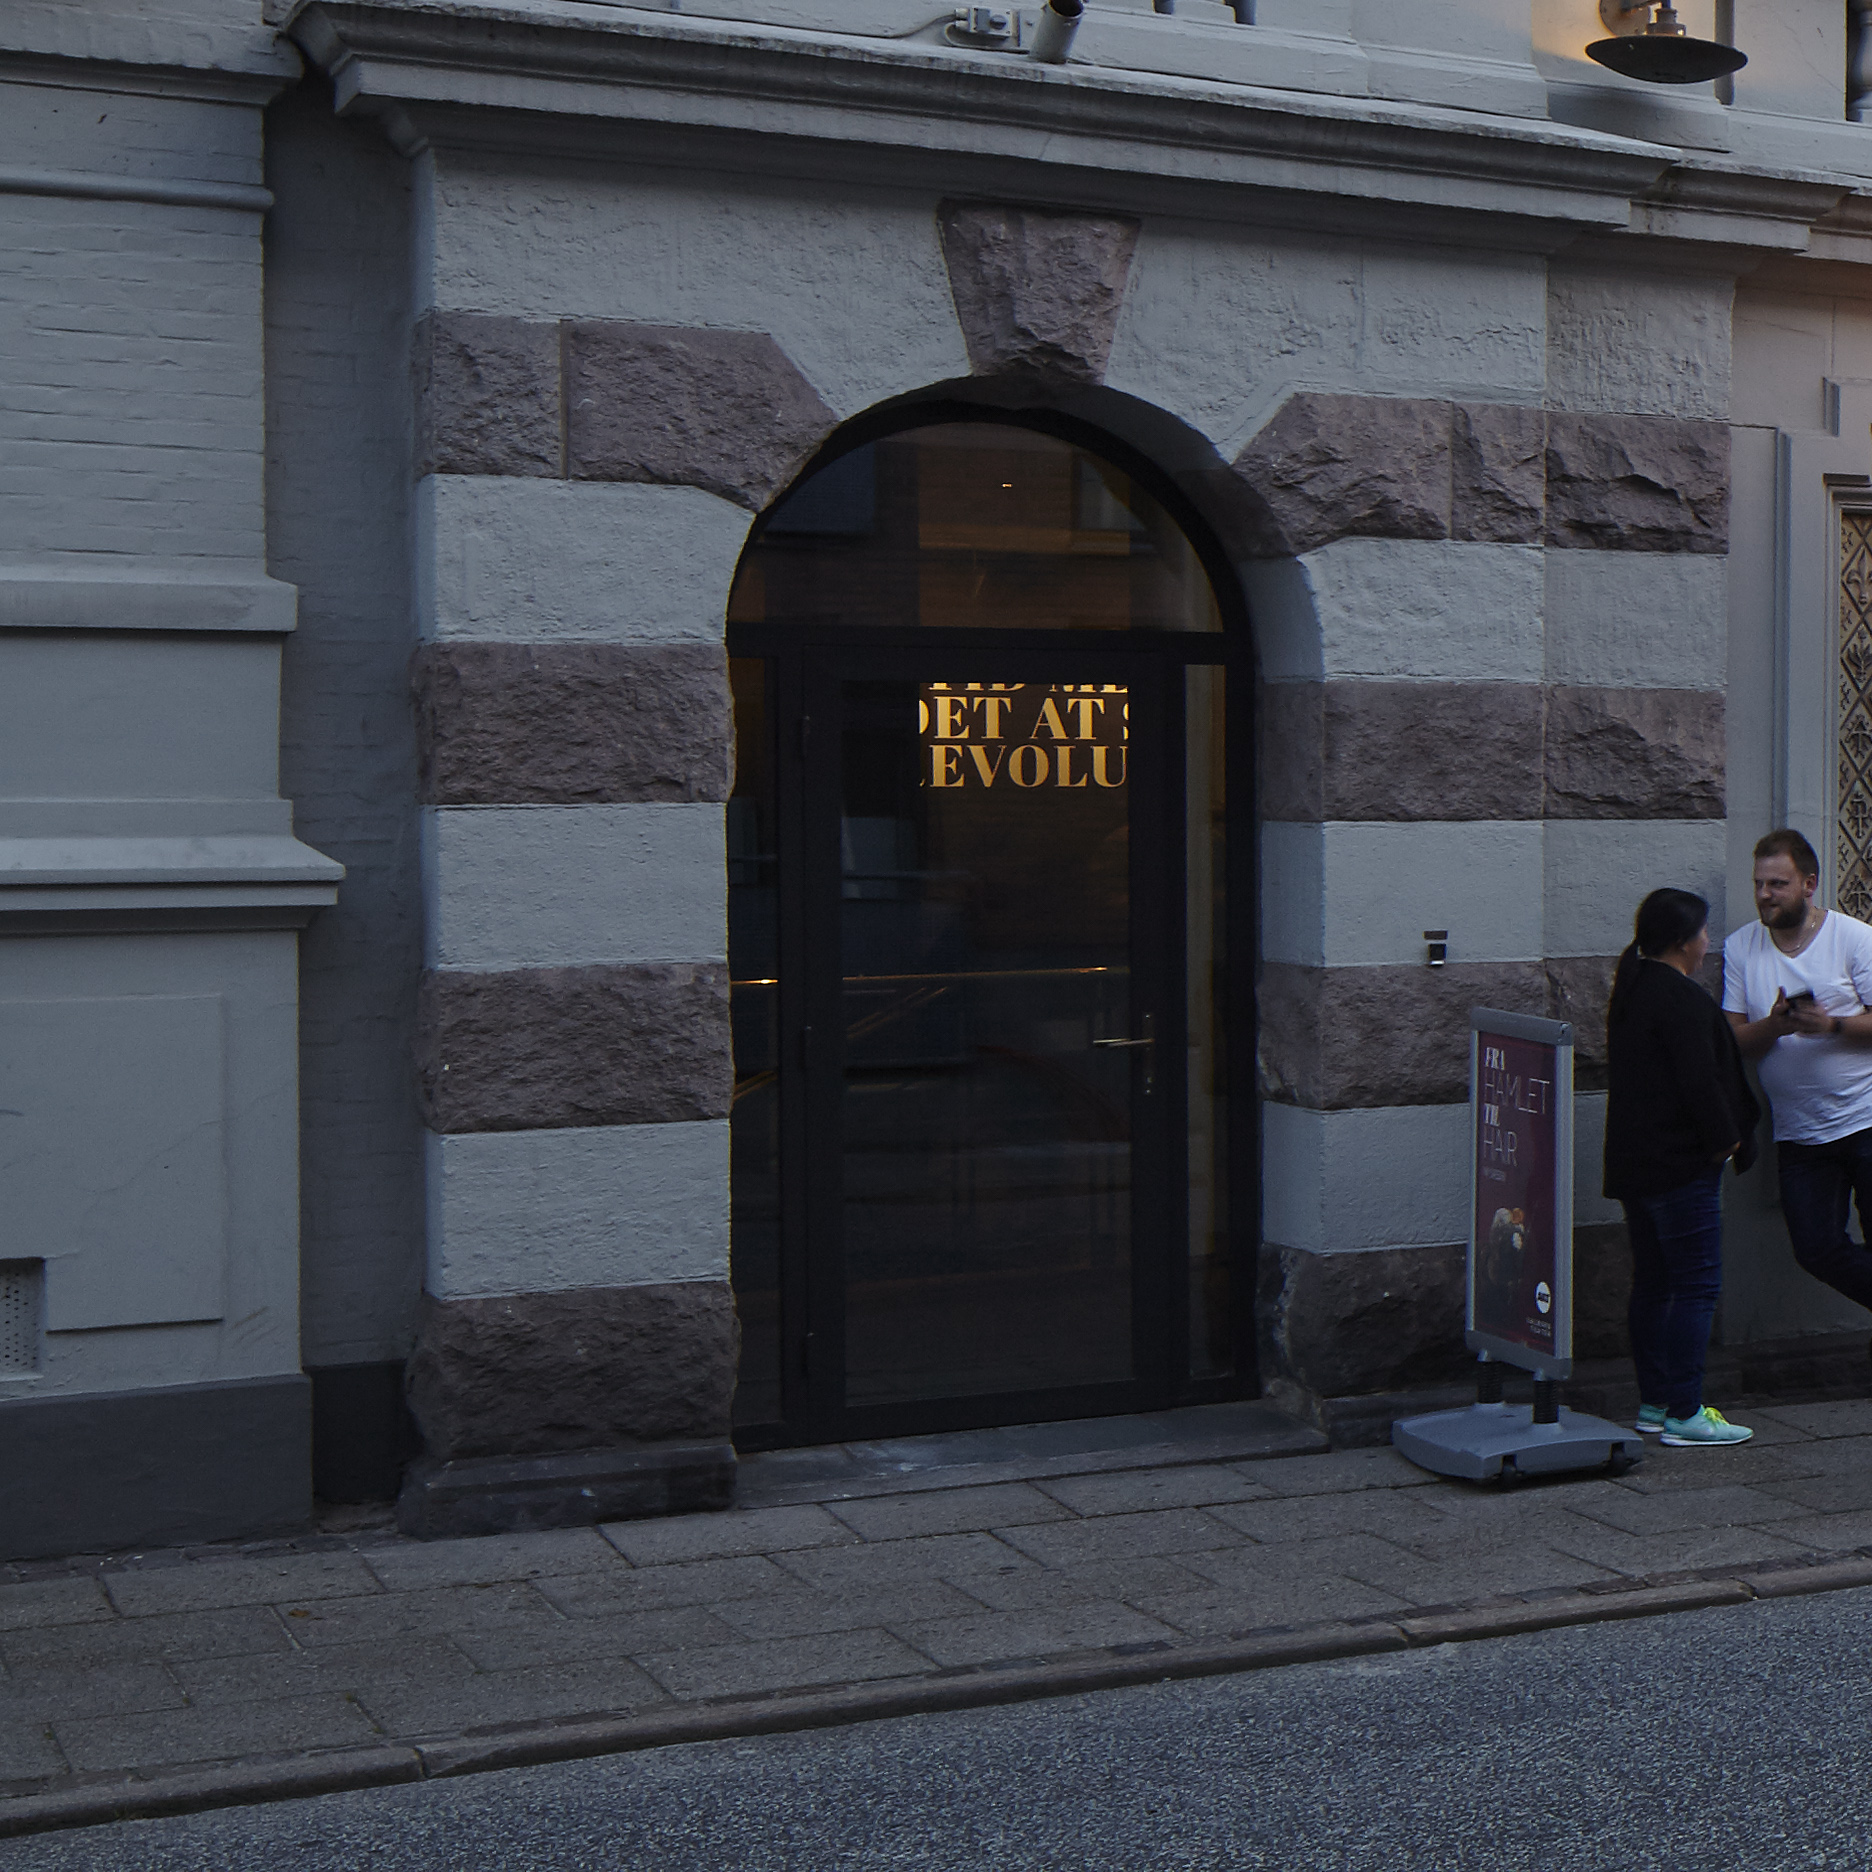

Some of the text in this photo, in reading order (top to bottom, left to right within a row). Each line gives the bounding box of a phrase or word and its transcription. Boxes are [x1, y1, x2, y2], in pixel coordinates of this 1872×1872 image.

[1029, 697, 1105, 740] AT
[919, 744, 1128, 788] EVOLU
[1484, 1068, 1551, 1115] HAMLET
